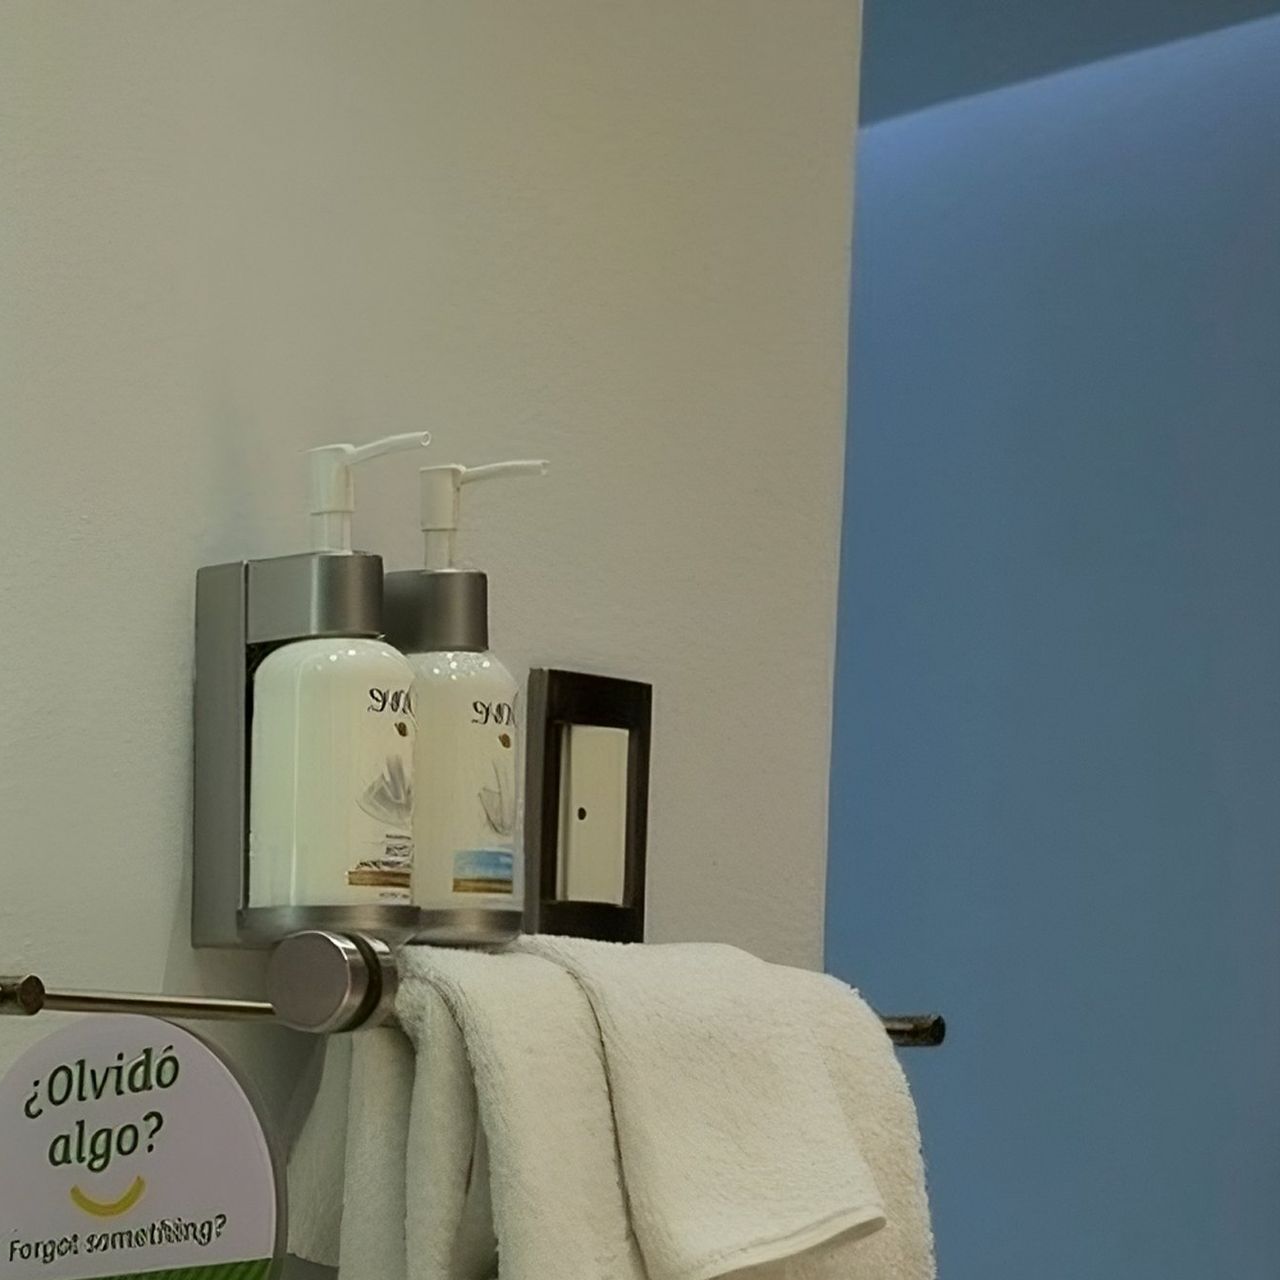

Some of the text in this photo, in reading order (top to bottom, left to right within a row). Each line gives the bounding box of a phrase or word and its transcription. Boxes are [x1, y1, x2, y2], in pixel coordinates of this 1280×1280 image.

[23, 1045, 180, 1119] ¿Olvidó
[48, 1111, 164, 1173] algo?
[8, 1213, 228, 1265] Forgot something?
